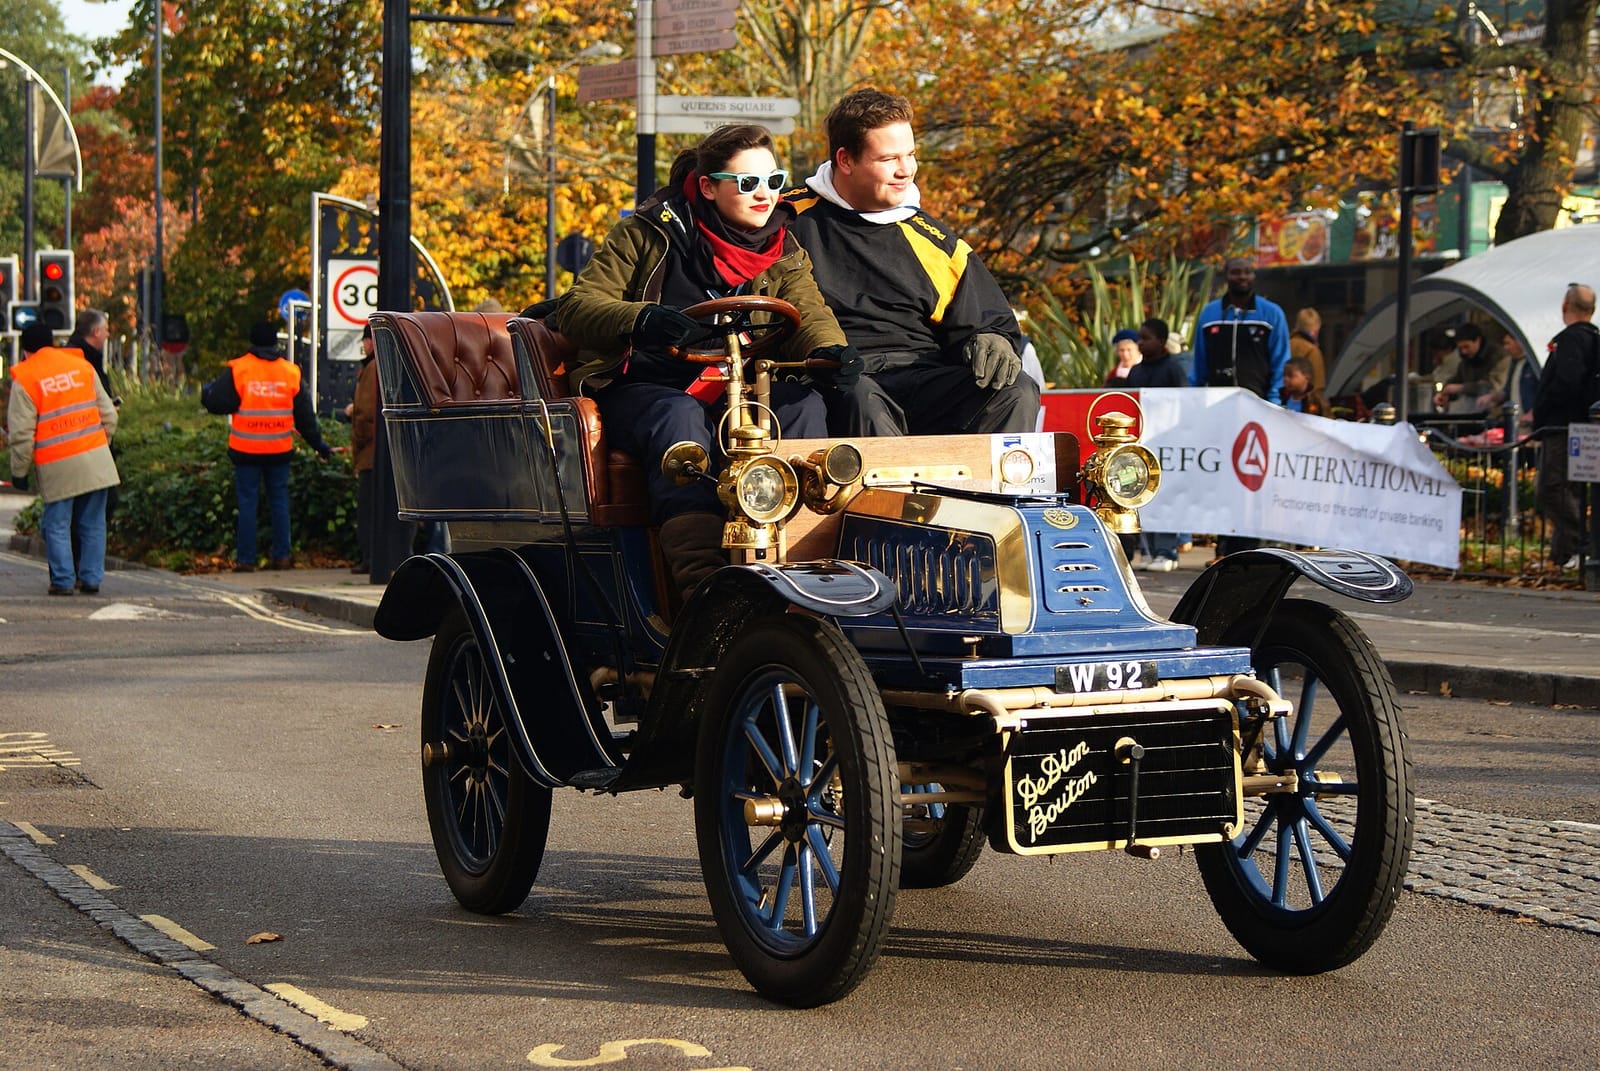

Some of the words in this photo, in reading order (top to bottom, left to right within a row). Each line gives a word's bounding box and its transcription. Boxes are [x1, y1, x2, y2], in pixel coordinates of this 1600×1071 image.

[681, 101, 727, 111] QUEENS
[729, 102, 775, 112] SQUARE
[343, 284, 379, 307] 30
[247, 421, 285, 429] OFFICIAL
[1158, 446, 1220, 472] EFG
[1273, 452, 1447, 497] INTERNATIONAL
[1333, 502, 1347, 516] the
[1349, 505, 1368, 519] craft
[1379, 509, 1407, 526] private
[1408, 512, 1443, 531] banking
[1069, 663, 1095, 692] W
[1106, 661, 1143, 689] 92
[1028, 770, 1097, 843] Bouton
